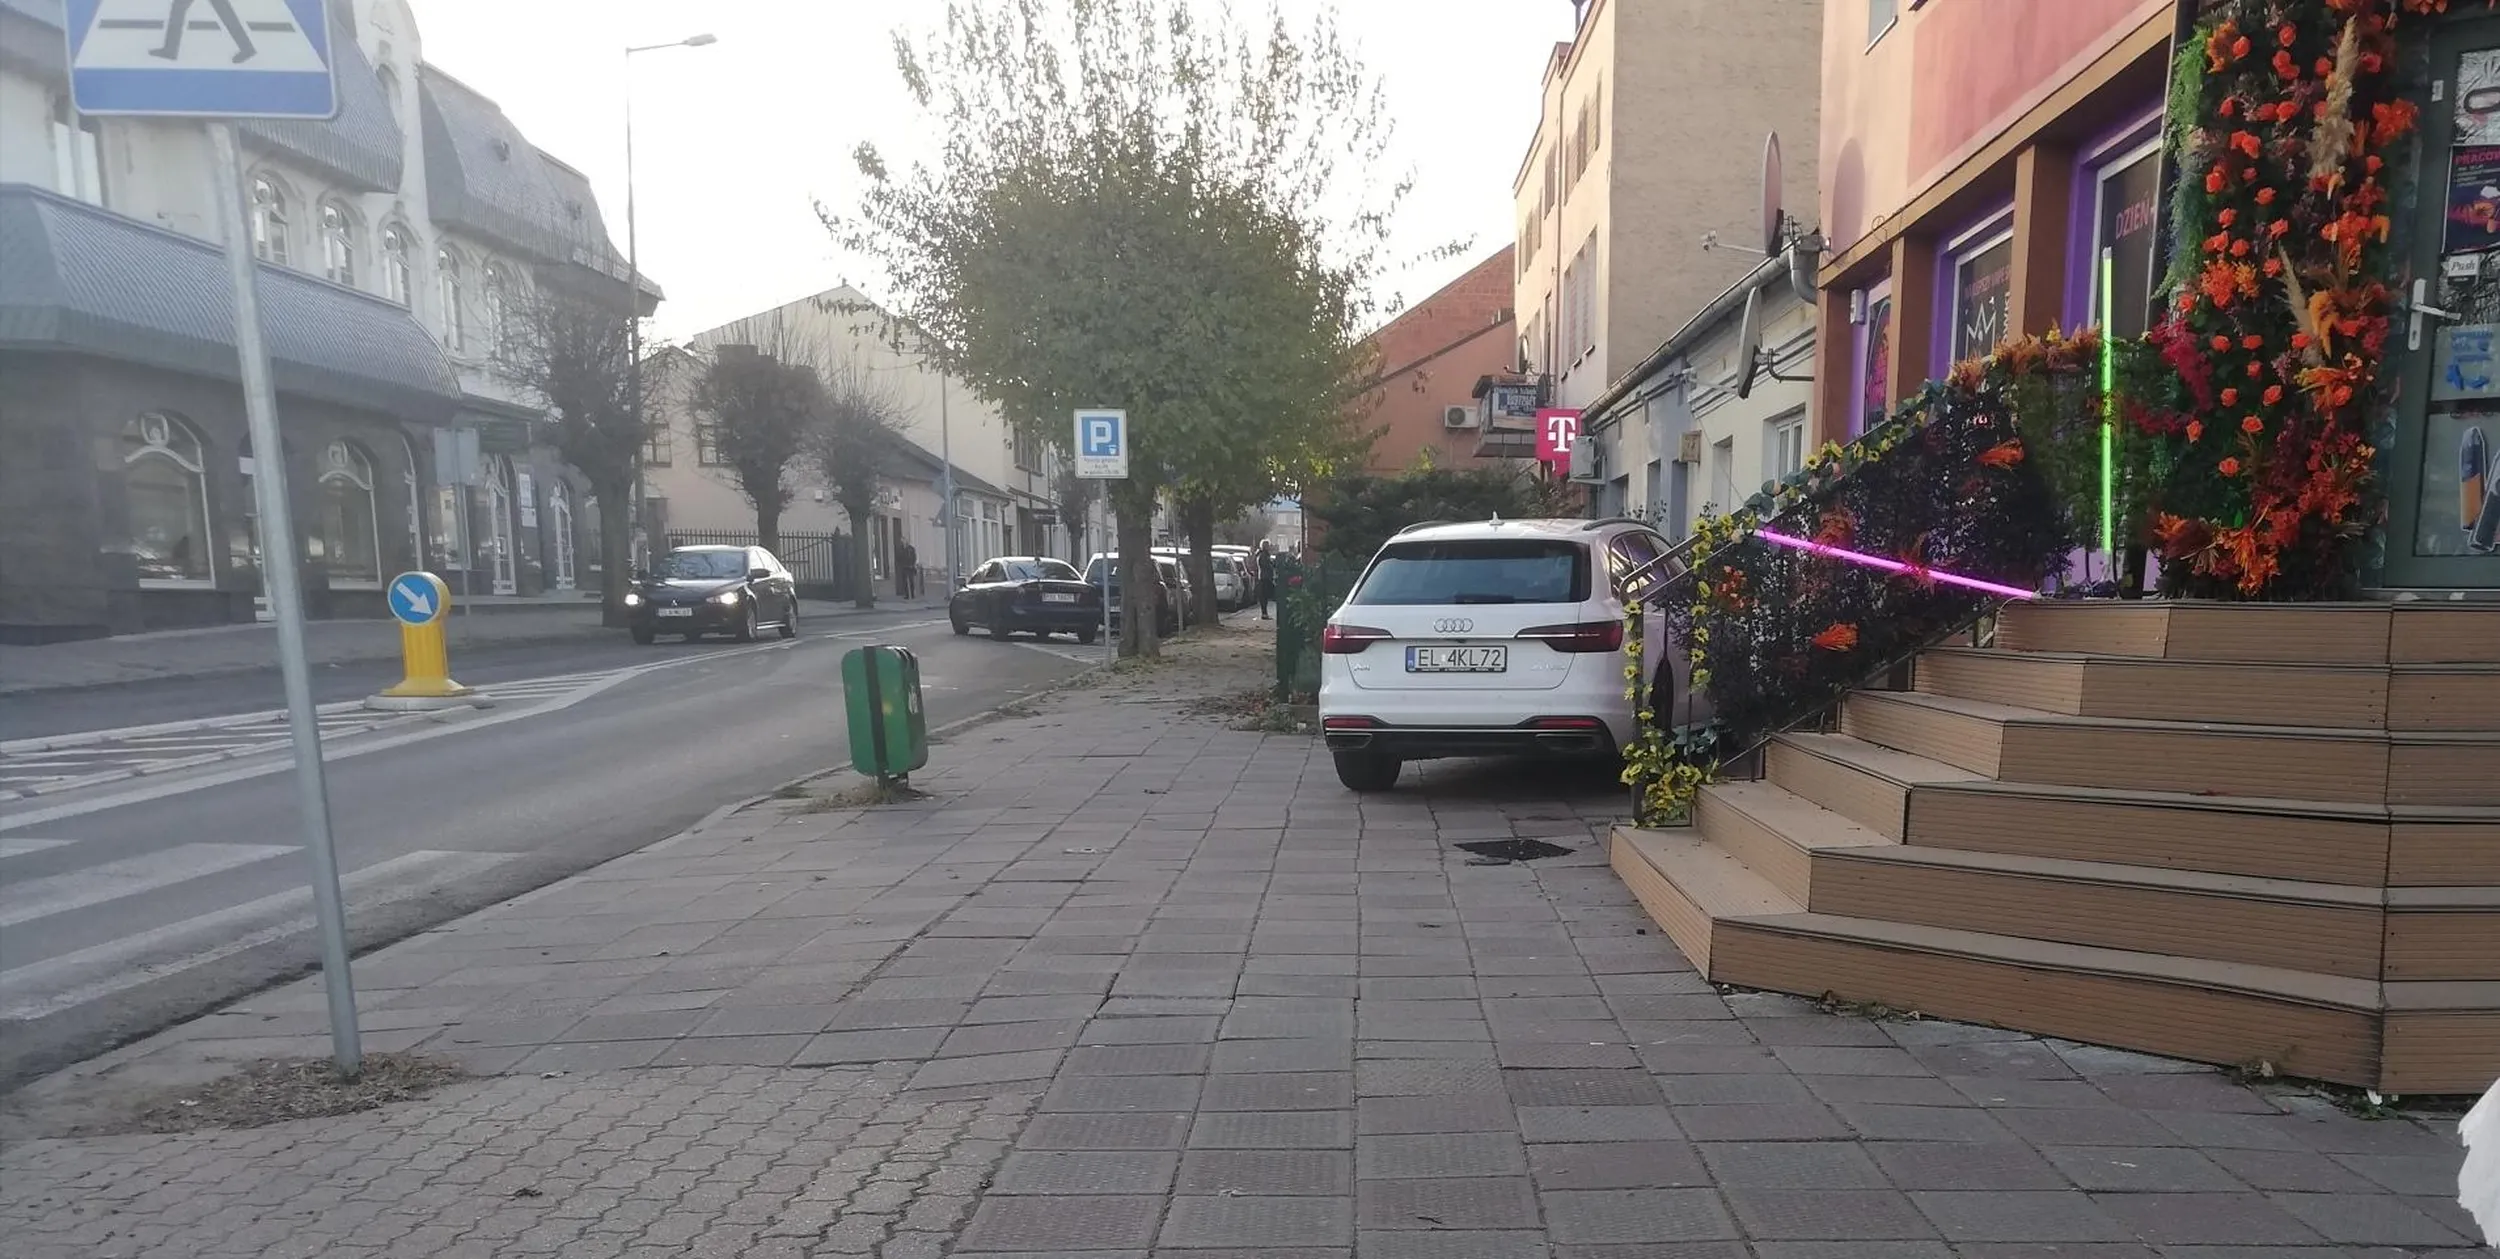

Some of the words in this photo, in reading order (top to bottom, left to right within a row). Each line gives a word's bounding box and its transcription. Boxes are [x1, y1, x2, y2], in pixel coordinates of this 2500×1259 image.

[2451, 259, 2476, 271] Push
[1090, 420, 1112, 452] P
[1548, 416, 1576, 452] T
[1418, 649, 1440, 667] EL
[1447, 649, 1502, 667] 4KL72
